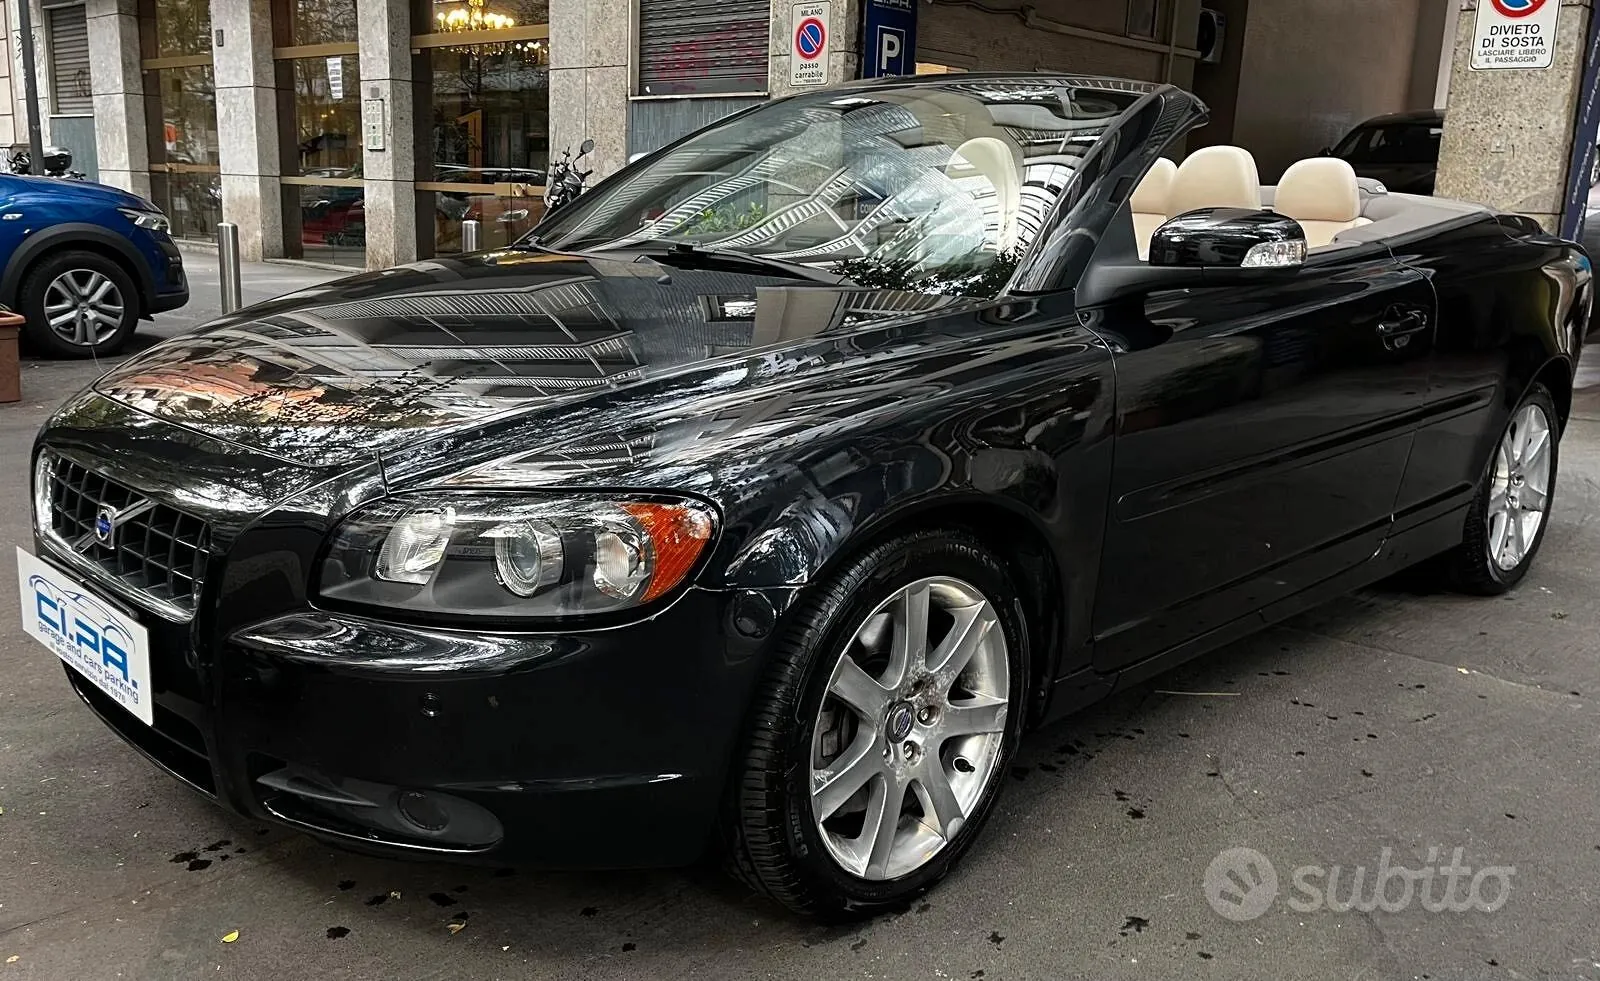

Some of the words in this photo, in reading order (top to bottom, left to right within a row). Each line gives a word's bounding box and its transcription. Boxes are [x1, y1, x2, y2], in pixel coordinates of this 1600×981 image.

[1490, 24, 1540, 36] DIVIETO
[1482, 38, 1495, 48] DI
[1501, 36, 1544, 48] SOSTA
[881, 33, 900, 70] P
[1478, 49, 1515, 57] LASCIARE
[1518, 48, 1547, 56] LIBERO
[799, 63, 819, 71] passo
[795, 71, 823, 79] carrabile
[38, 621, 65, 646] garage
[67, 641, 82, 659] and
[83, 654, 103, 675] cars
[104, 669, 139, 705] parking
